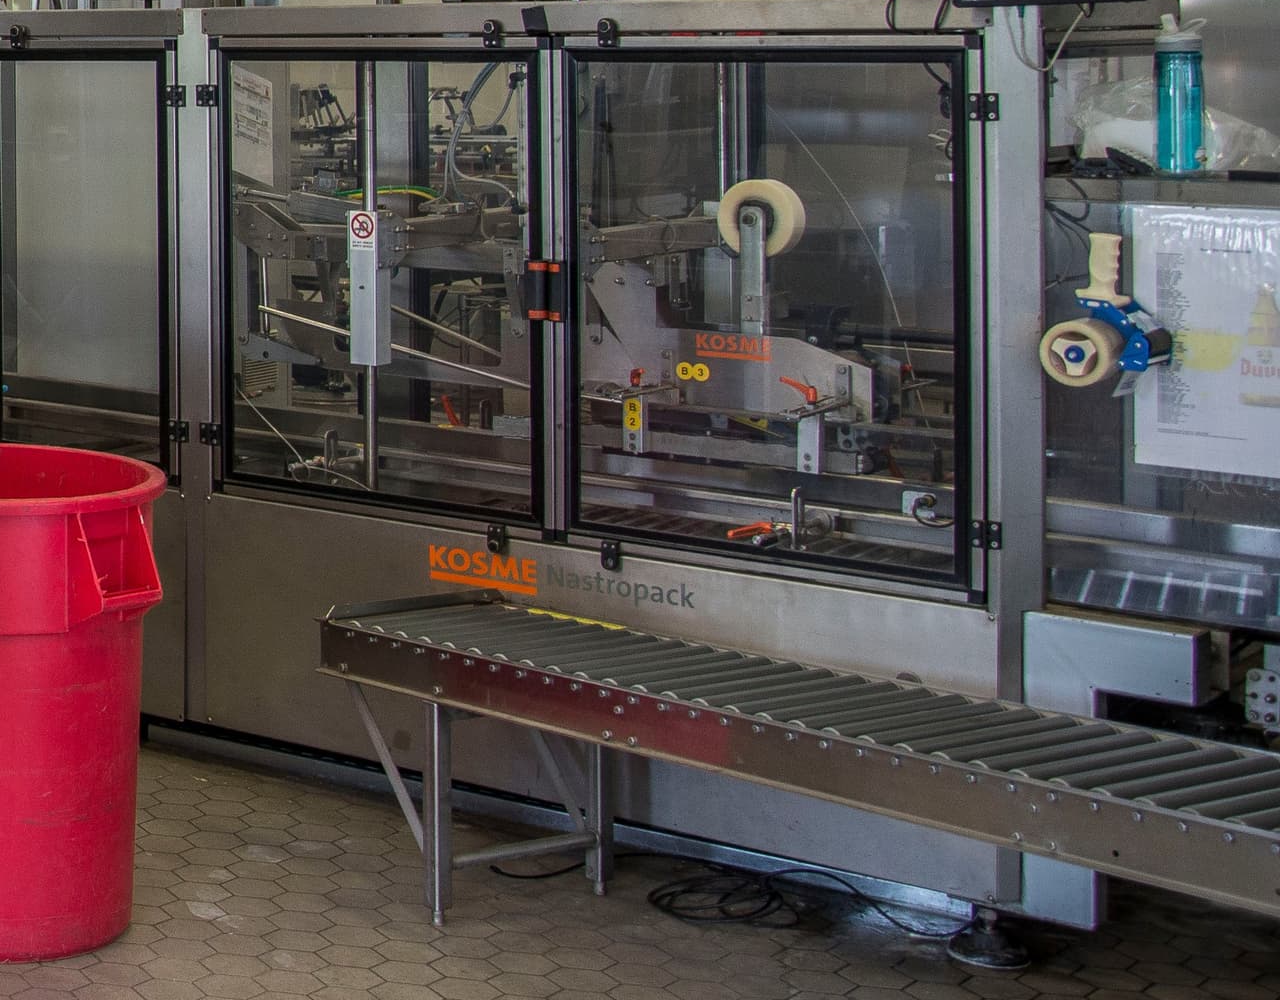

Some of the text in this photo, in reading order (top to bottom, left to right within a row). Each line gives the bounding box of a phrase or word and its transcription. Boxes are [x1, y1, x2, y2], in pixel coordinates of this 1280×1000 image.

[695, 332, 771, 354] KOSME
[681, 366, 704, 377] B 3
[429, 544, 696, 609] KOSME Nastropack
